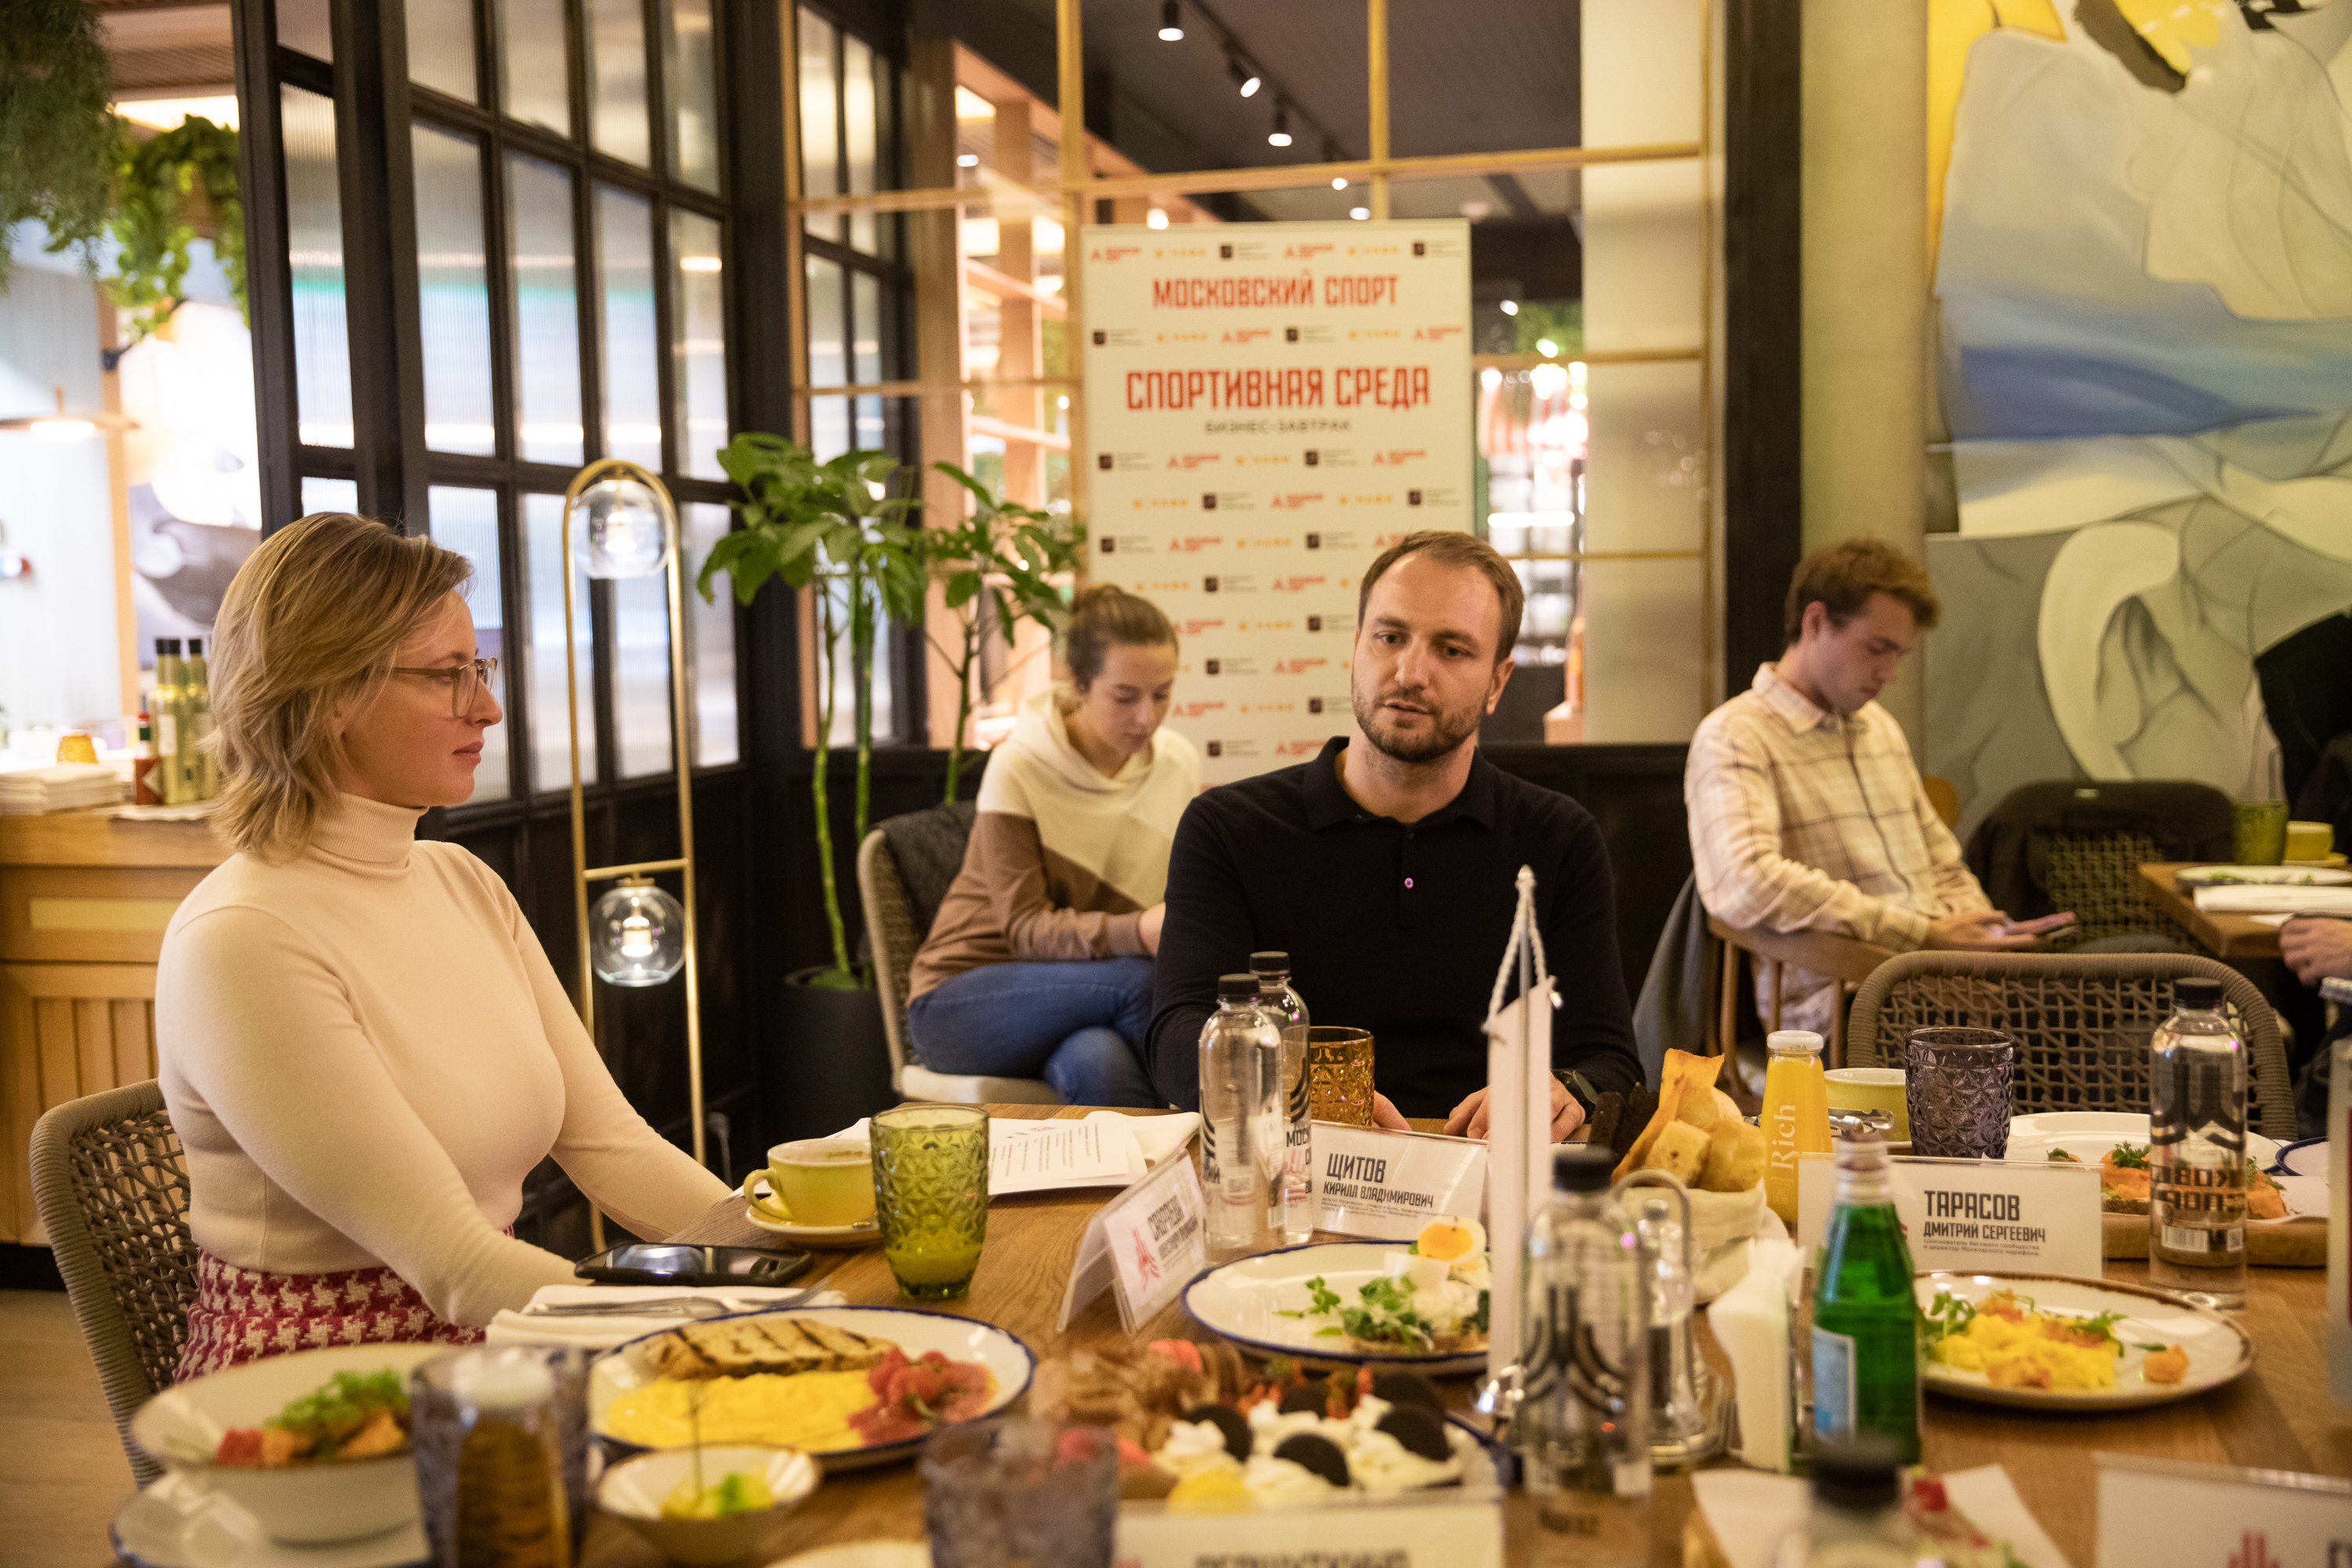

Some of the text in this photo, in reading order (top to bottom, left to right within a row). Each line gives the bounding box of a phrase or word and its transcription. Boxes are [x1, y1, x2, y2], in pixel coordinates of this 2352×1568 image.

[1152, 270, 1399, 308] МОСКОВСКИЙ СПОРТ
[1127, 367, 1429, 411] СПОРТИВНАЯ СРЕДА
[1770, 1105, 1795, 1169] Rich
[1327, 1153, 1387, 1183] ЩИТОВ
[1323, 1181, 1359, 1198] КИРИЛЛ
[1360, 1186, 1434, 1208] ВЛАДИМИРОВИЧ
[1924, 1190, 2020, 1221] ТАРАСОВ
[1923, 1221, 2045, 1243] ДМИТРИЙ СЕРГЕЕВИЧ
